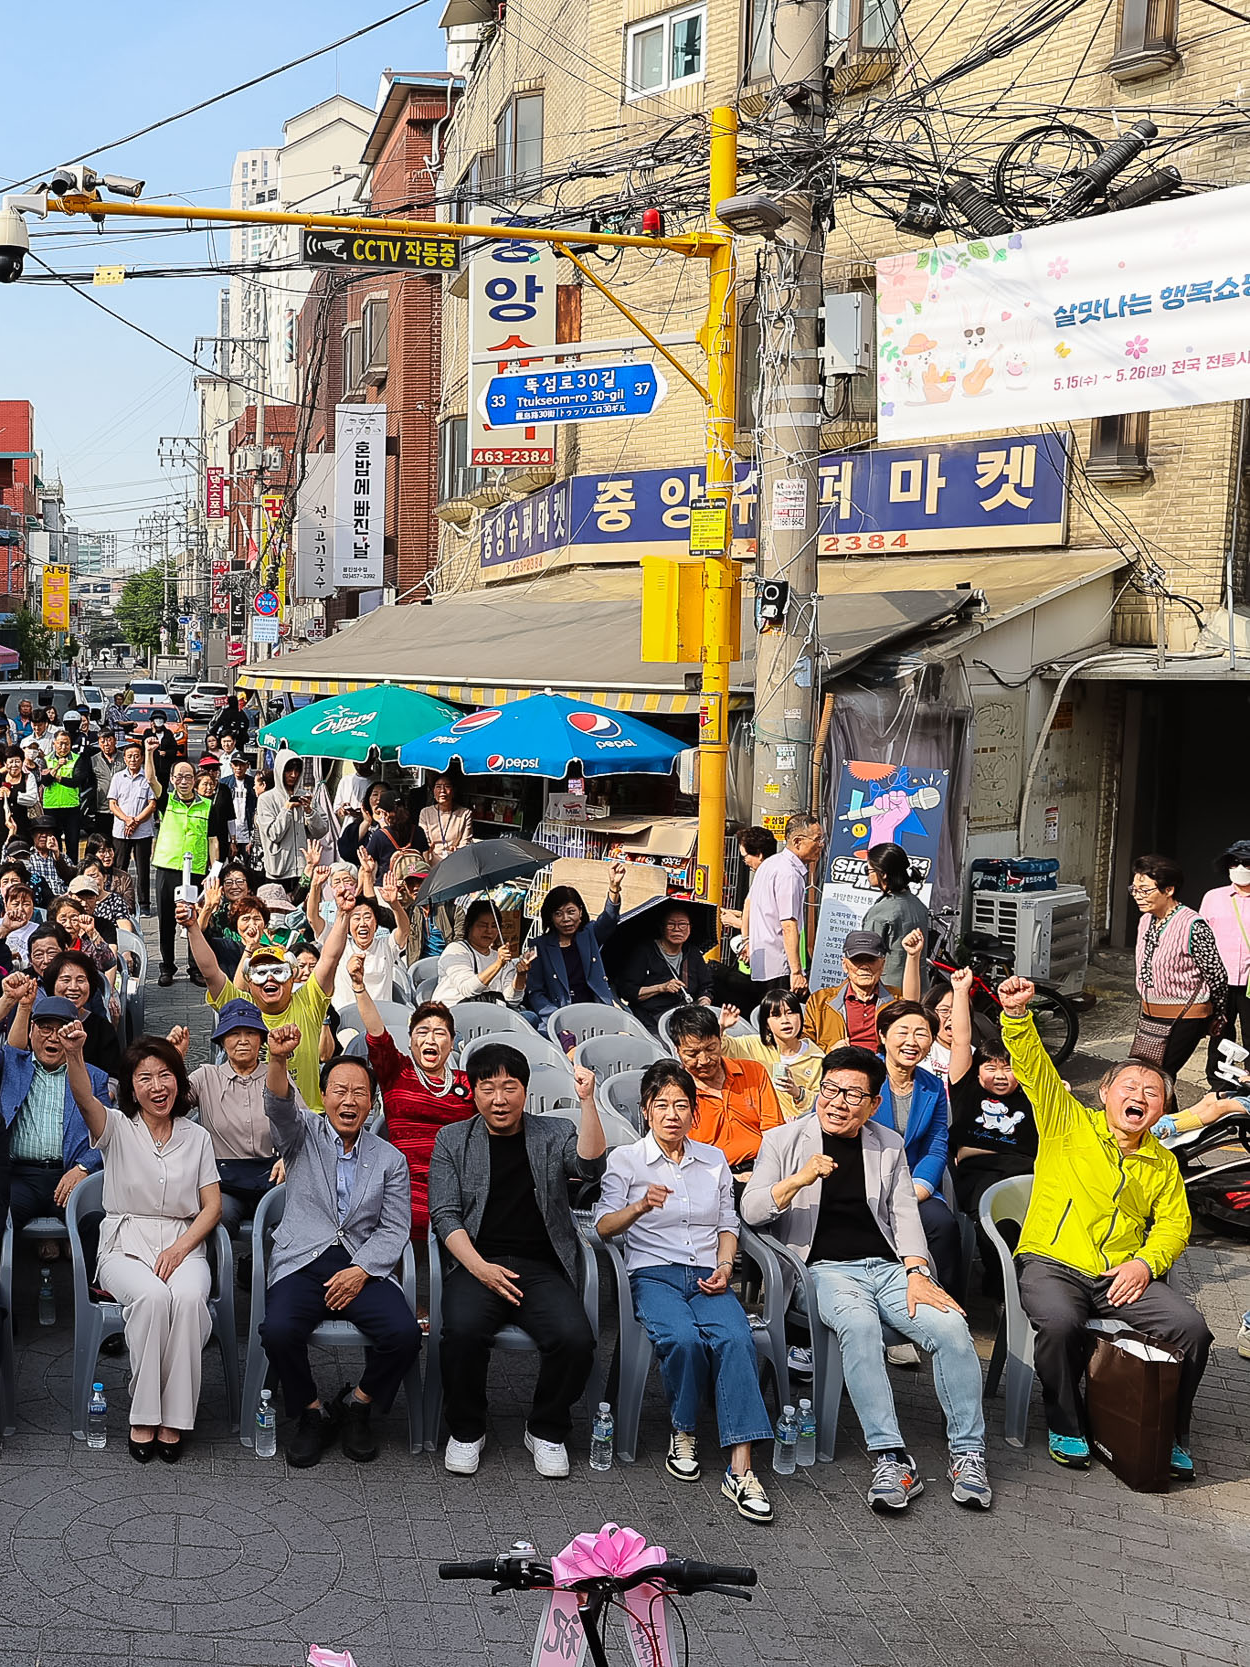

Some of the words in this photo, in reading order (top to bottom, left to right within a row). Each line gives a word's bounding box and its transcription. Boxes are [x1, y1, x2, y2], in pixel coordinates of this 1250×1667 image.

[352, 238, 401, 263] CCTV
[405, 240, 456, 268] 작동중
[1053, 292, 1152, 328] 살맛나는
[524, 369, 616, 394] 뚝섬로30길
[1053, 374, 1098, 391] 5.15(수)
[1116, 364, 1167, 382] 5.26(일)
[1172, 357, 1201, 375] 전국
[516, 394, 588, 409] Ttukseom-ro
[591, 388, 624, 404] 30-gil
[634, 382, 651, 396] 37
[491, 394, 506, 408] 33
[353, 441, 372, 496] 혼밥에
[474, 449, 550, 465] 463-2384
[353, 500, 371, 536] 빠진
[483, 487, 567, 560] 중앙슈퍼마켓
[353, 541, 371, 560] 날
[46, 577, 66, 625] 부동산
[595, 737, 638, 750] pepsi
[504, 756, 540, 771] pepsi
[833, 856, 868, 875] SHO
